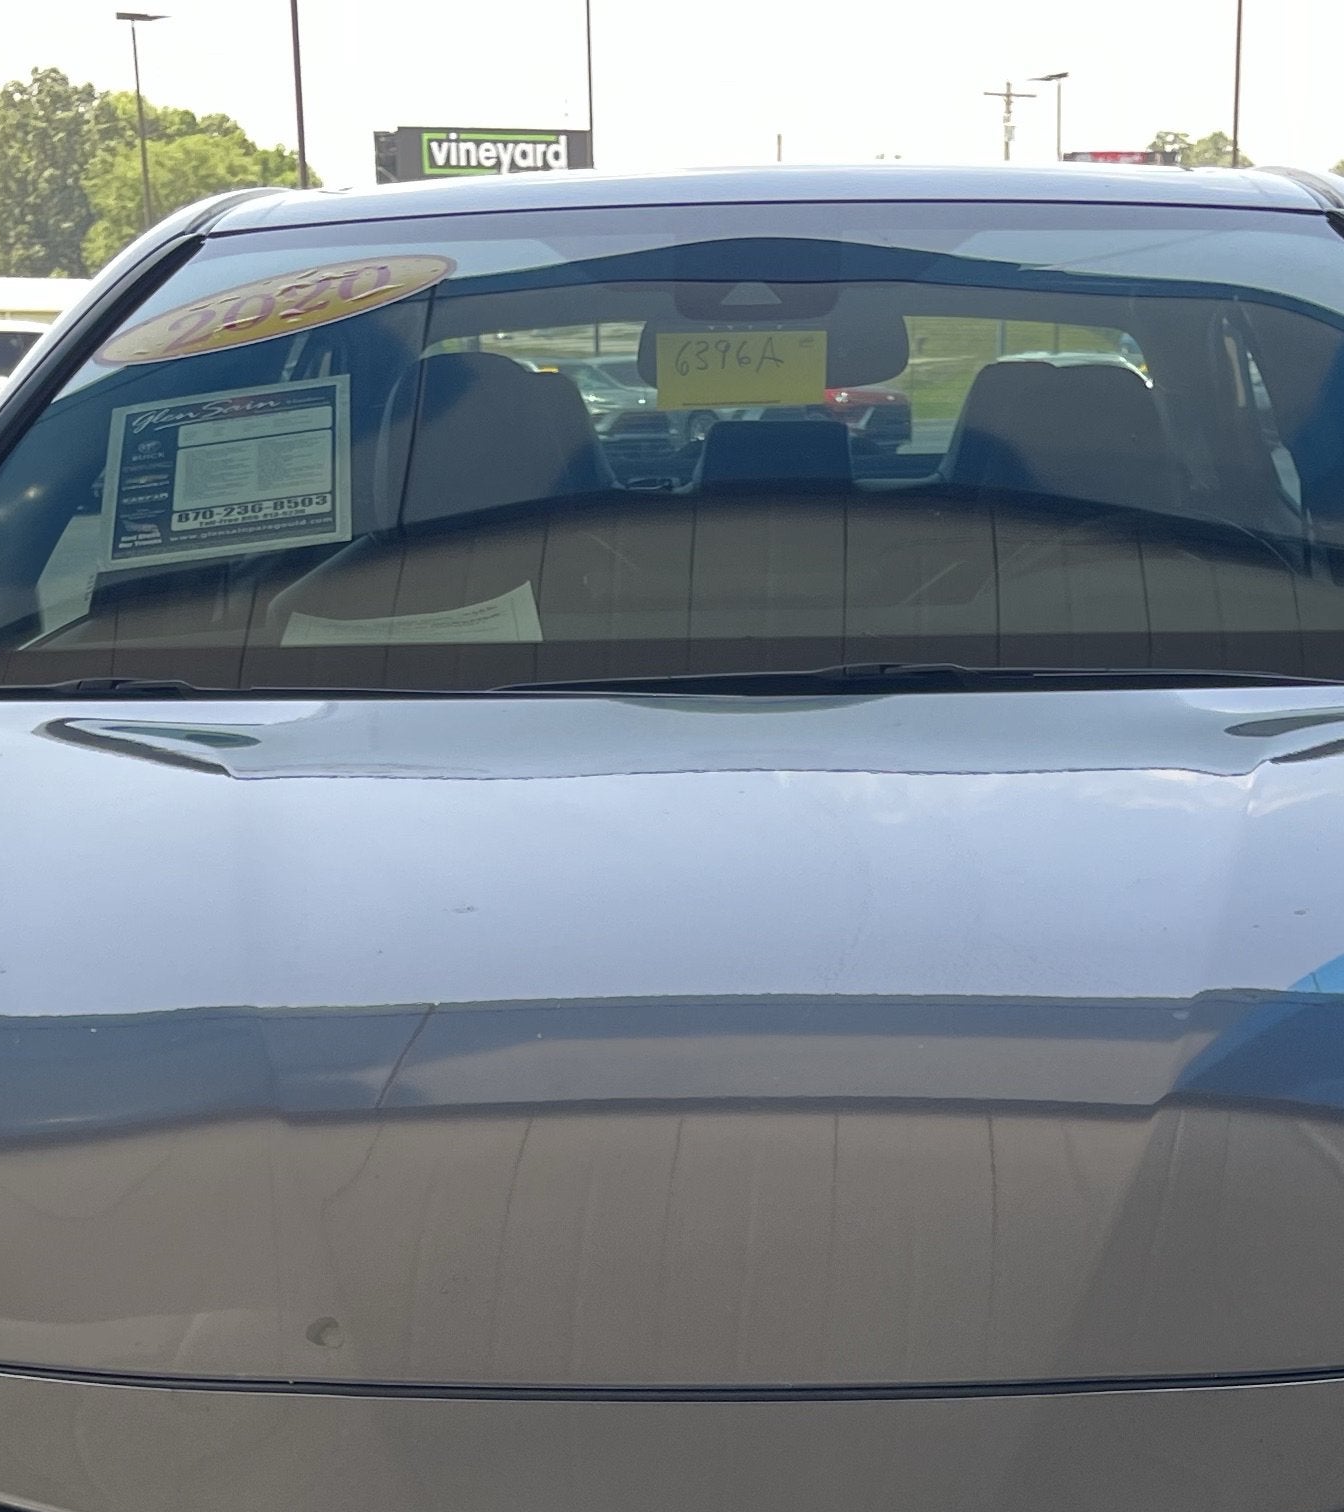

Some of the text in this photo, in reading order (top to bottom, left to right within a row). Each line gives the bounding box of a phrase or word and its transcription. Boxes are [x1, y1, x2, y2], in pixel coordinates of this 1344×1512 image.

[429, 132, 568, 174] vineyard
[167, 265, 392, 350] 2020
[674, 336, 785, 377] 6396A
[131, 408, 200, 434] Glen
[201, 399, 281, 419] Sain
[176, 495, 328, 524] 870-236-8503
